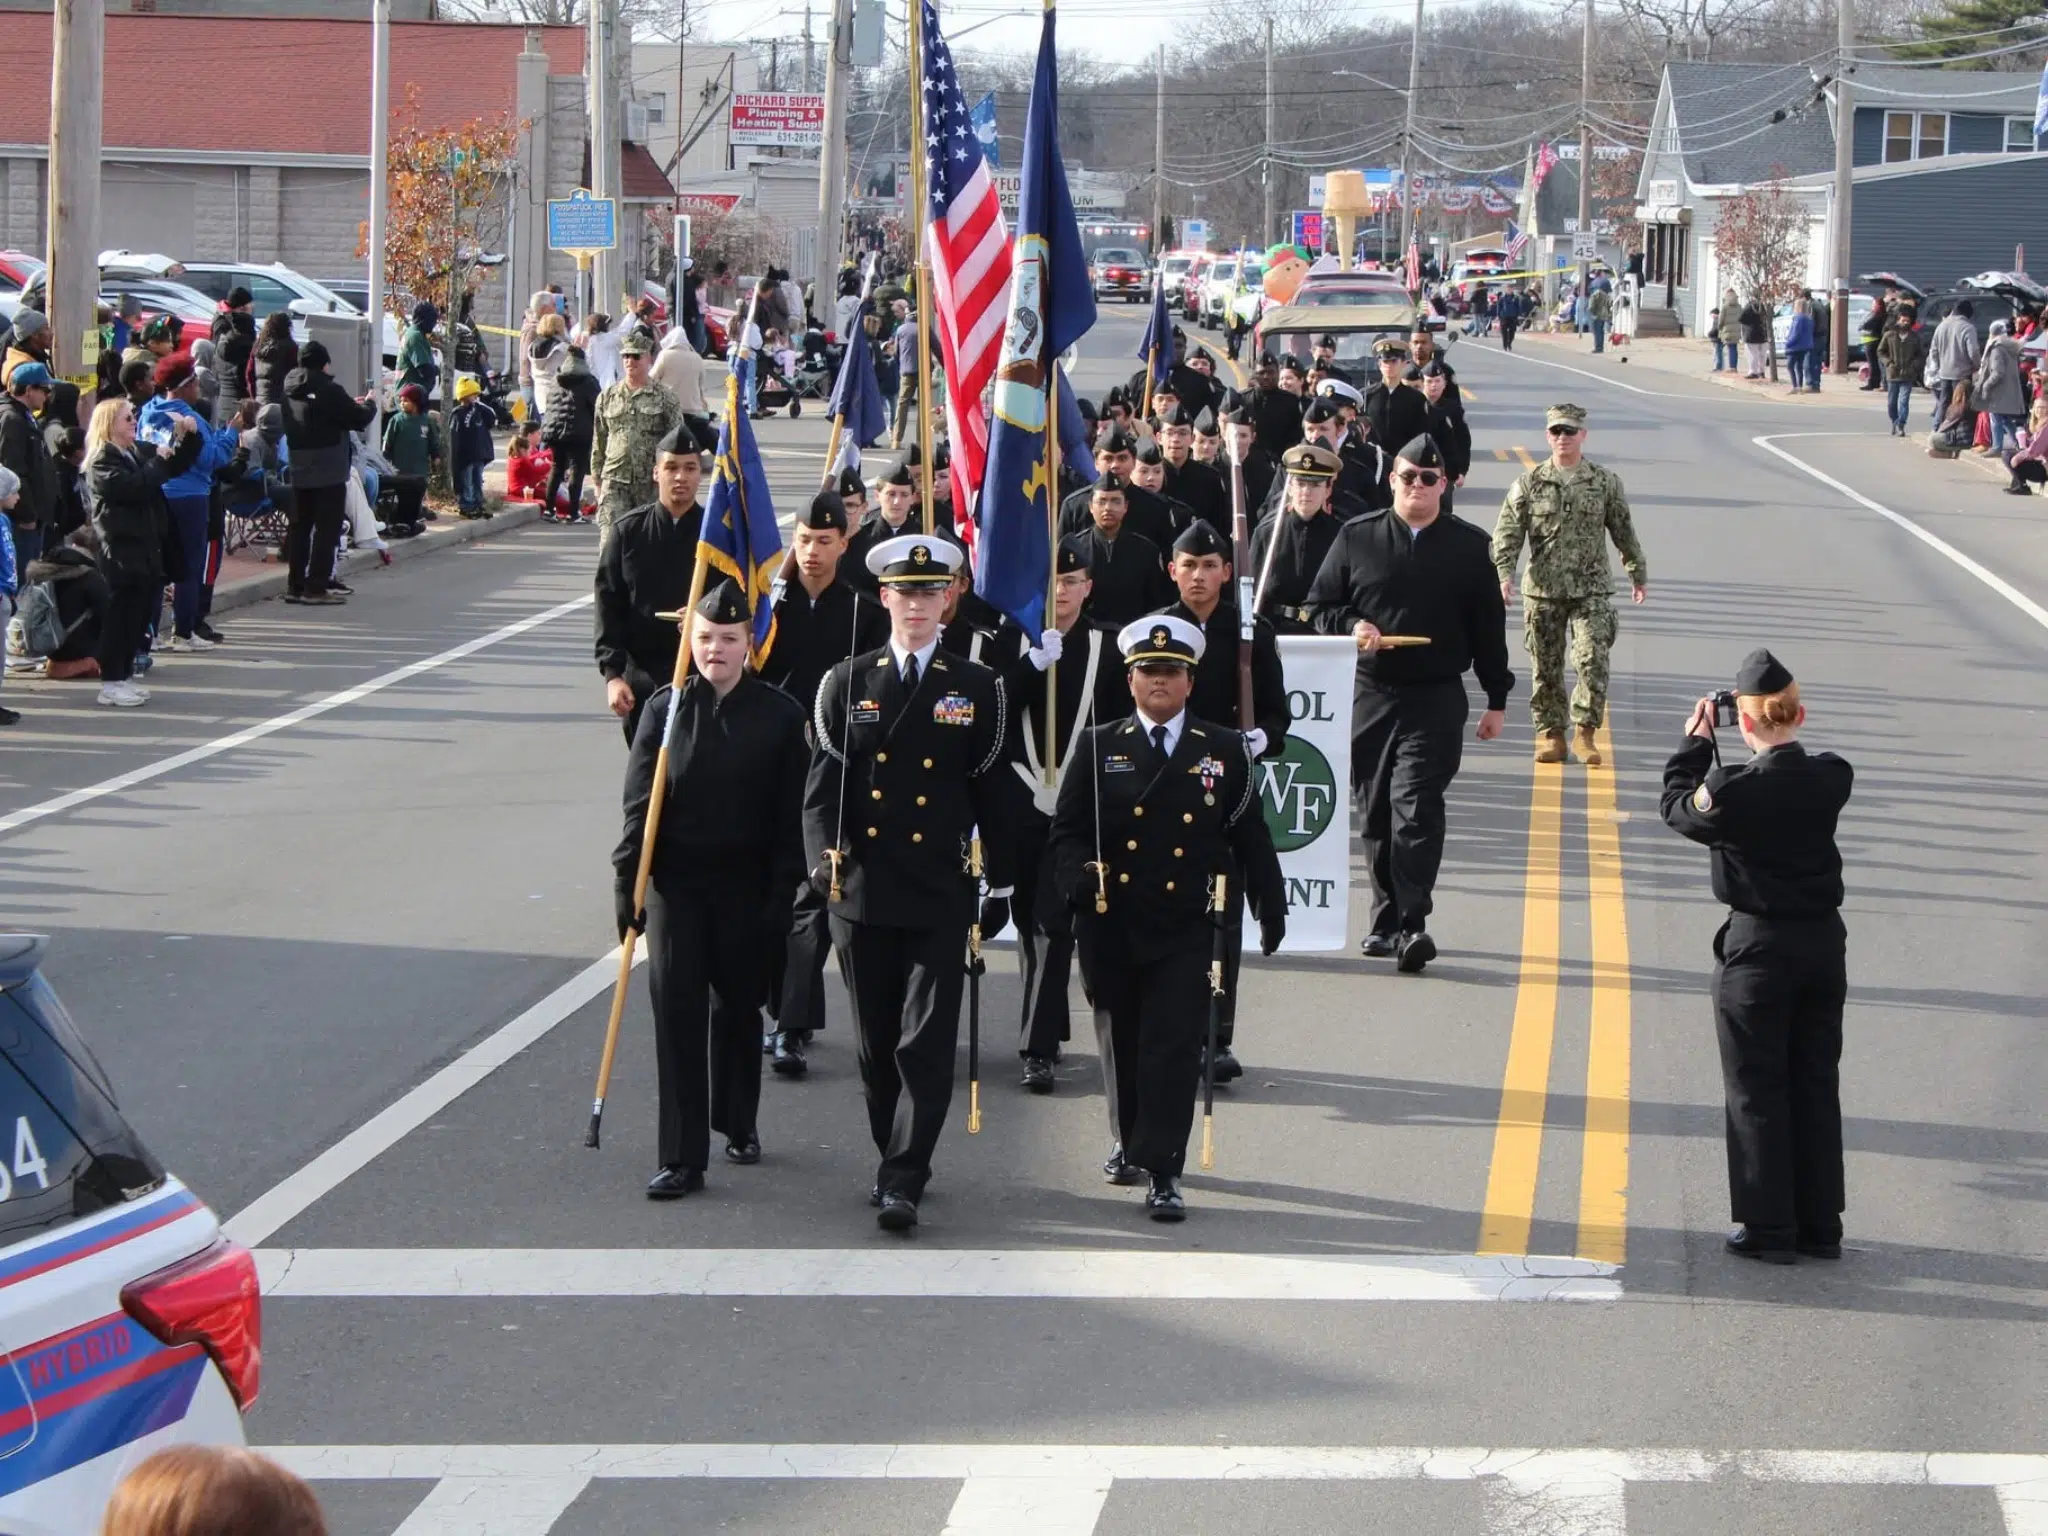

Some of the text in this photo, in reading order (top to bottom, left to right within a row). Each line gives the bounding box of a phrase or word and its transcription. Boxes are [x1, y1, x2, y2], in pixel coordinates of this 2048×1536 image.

[735, 95, 786, 106] RICHARD
[736, 117, 784, 129] Heating
[748, 108, 817, 120] Plumbing &
[1575, 247, 1594, 258] 45
[1287, 690, 1335, 722] OL
[1259, 760, 1330, 835] WF
[1285, 877, 1335, 908] NT
[29, 1326, 131, 1388] HYBRID
